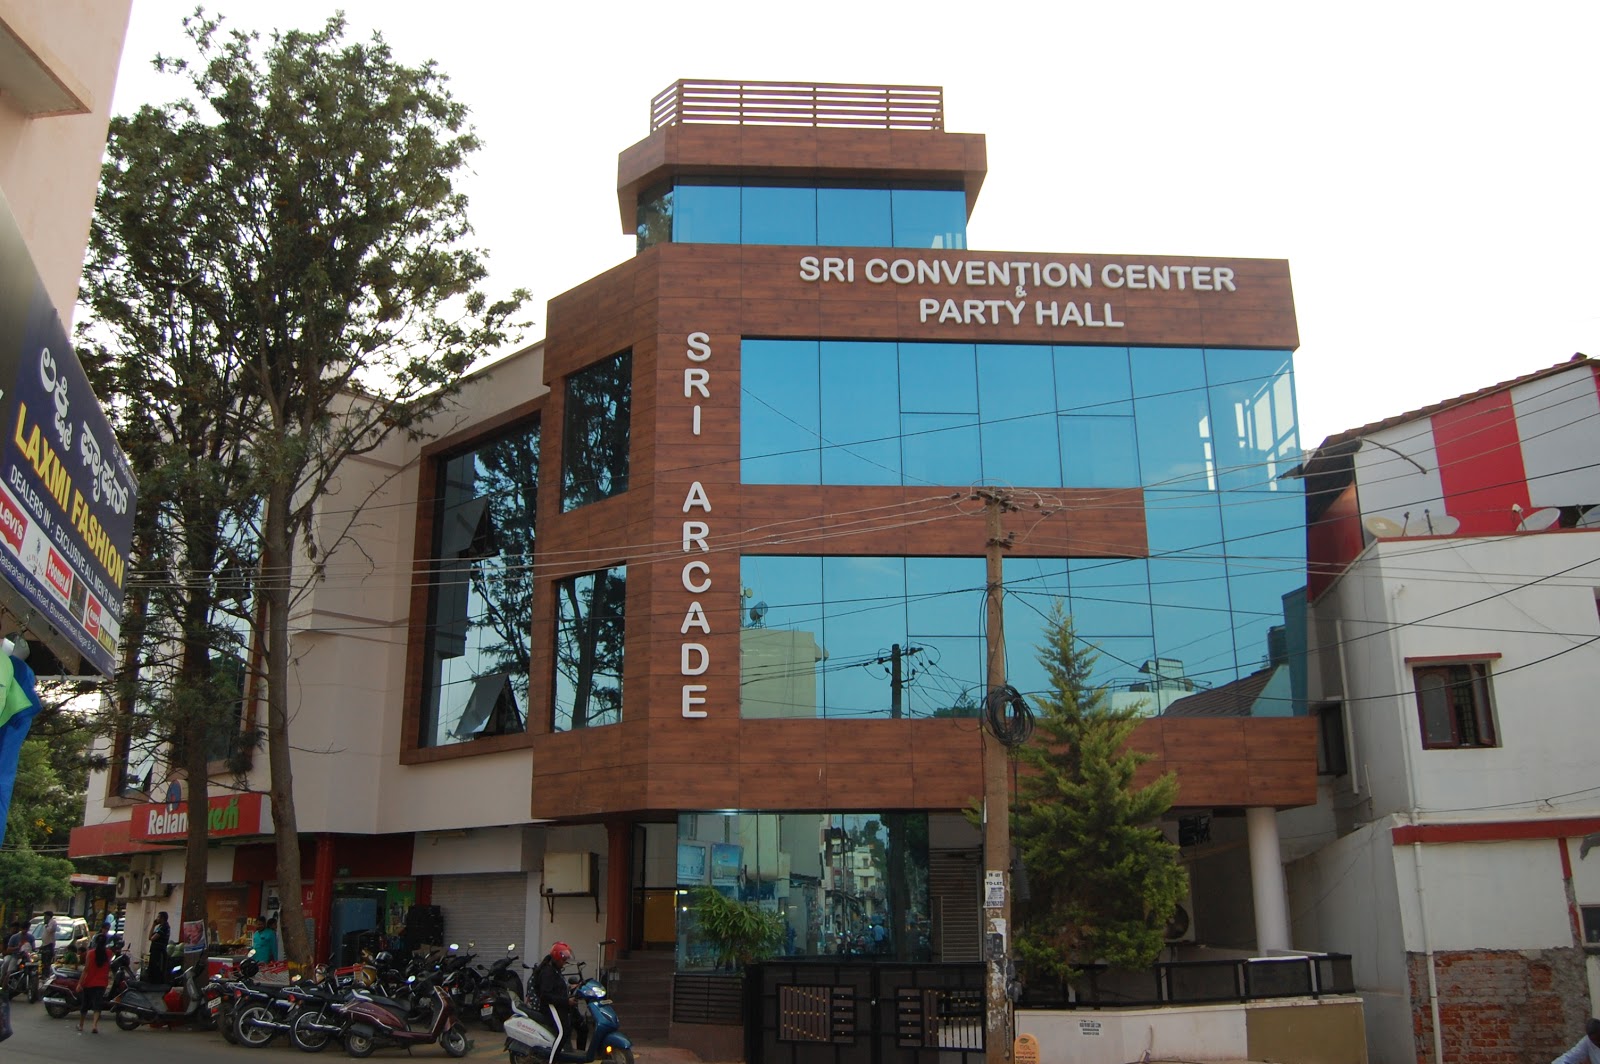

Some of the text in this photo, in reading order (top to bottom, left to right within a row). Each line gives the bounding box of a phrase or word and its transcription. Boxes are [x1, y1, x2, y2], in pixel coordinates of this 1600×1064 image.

[799, 256, 1236, 292] SRI CONVENTION CENTER
[1014, 285, 1027, 298] &
[919, 298, 1125, 328] PARTY HALL
[15, 401, 72, 513] LAXMI
[71, 488, 125, 590] FASHION
[10, 464, 44, 519] DEALERS
[55, 524, 86, 573] EXCLUSIVE
[680, 331, 712, 718] SRI ARCADE
[148, 806, 190, 835] Relian
